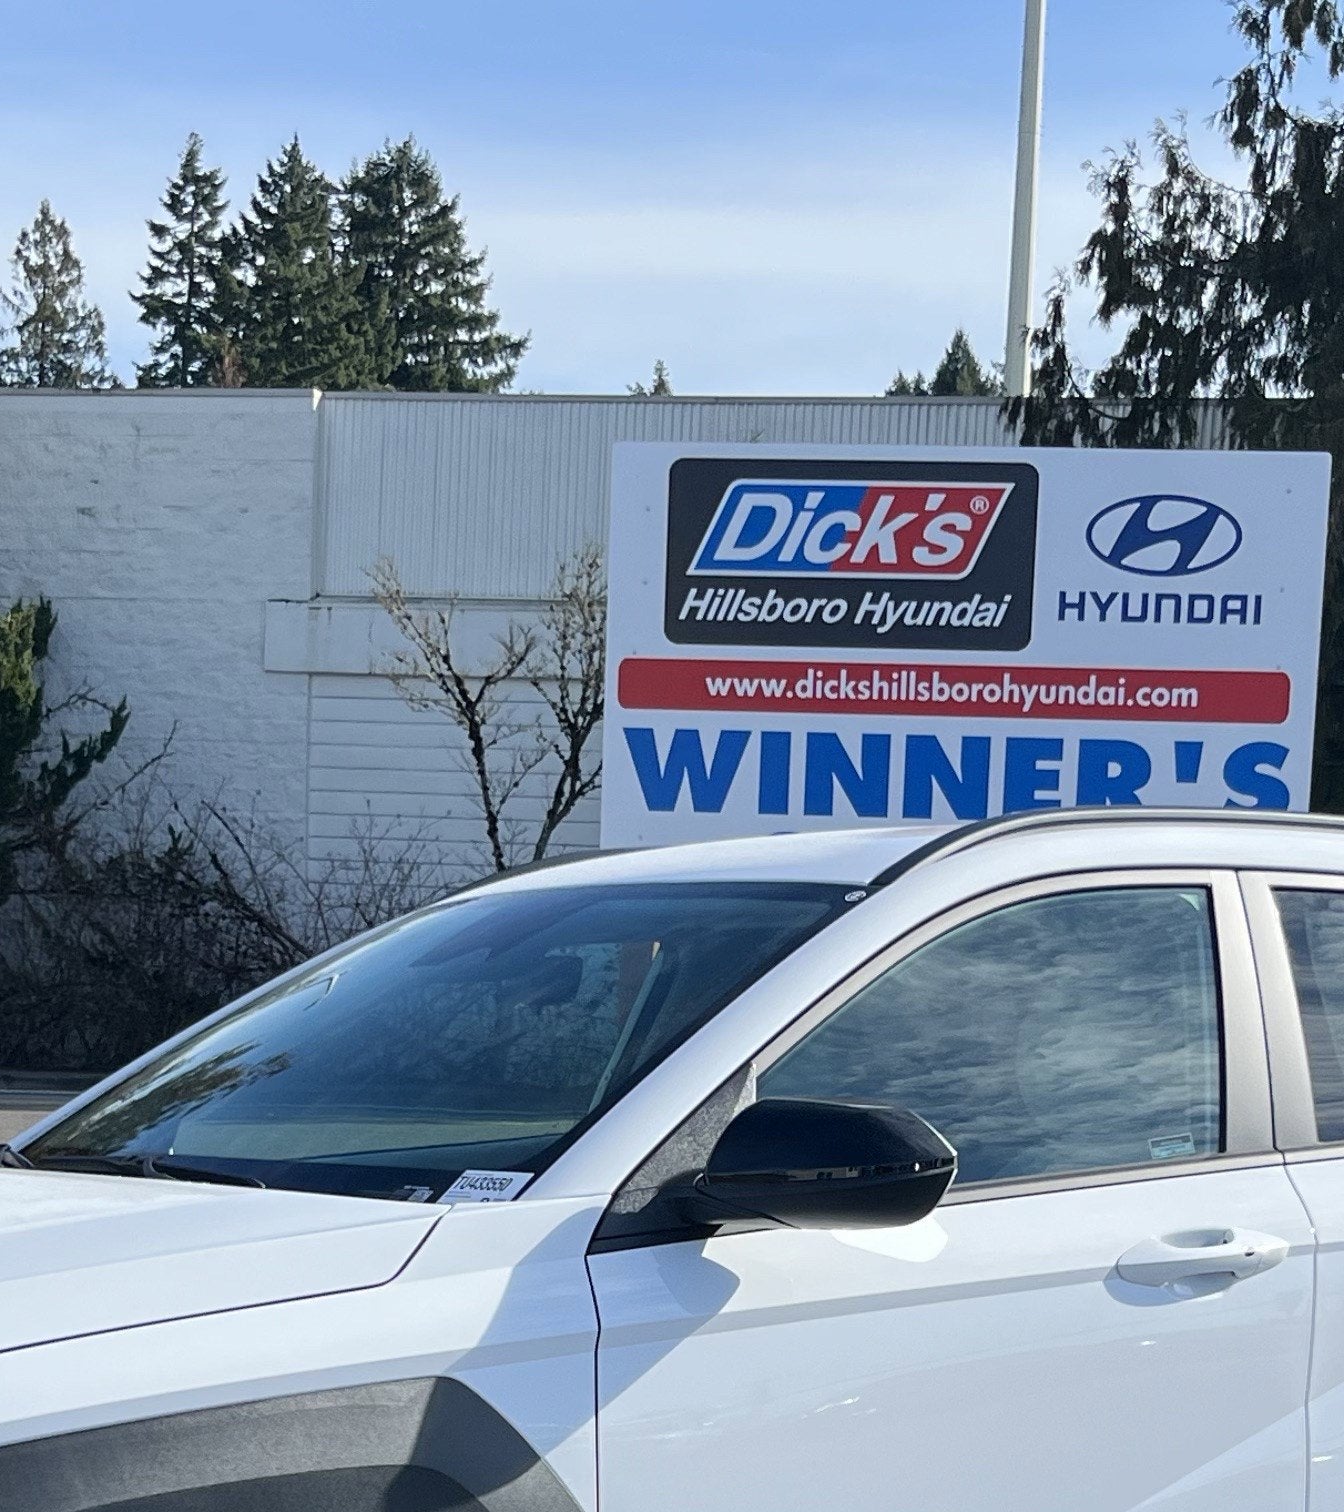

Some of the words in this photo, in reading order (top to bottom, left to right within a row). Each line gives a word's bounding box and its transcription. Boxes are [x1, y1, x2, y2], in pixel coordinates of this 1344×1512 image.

[678, 588, 848, 625] Hillsboro
[854, 592, 1012, 633] Hyundai
[1058, 591, 1261, 626] HYUNDAI
[705, 667, 1199, 711] www.dickshillsborohyundai.com
[622, 726, 1291, 820] WINNER'S
